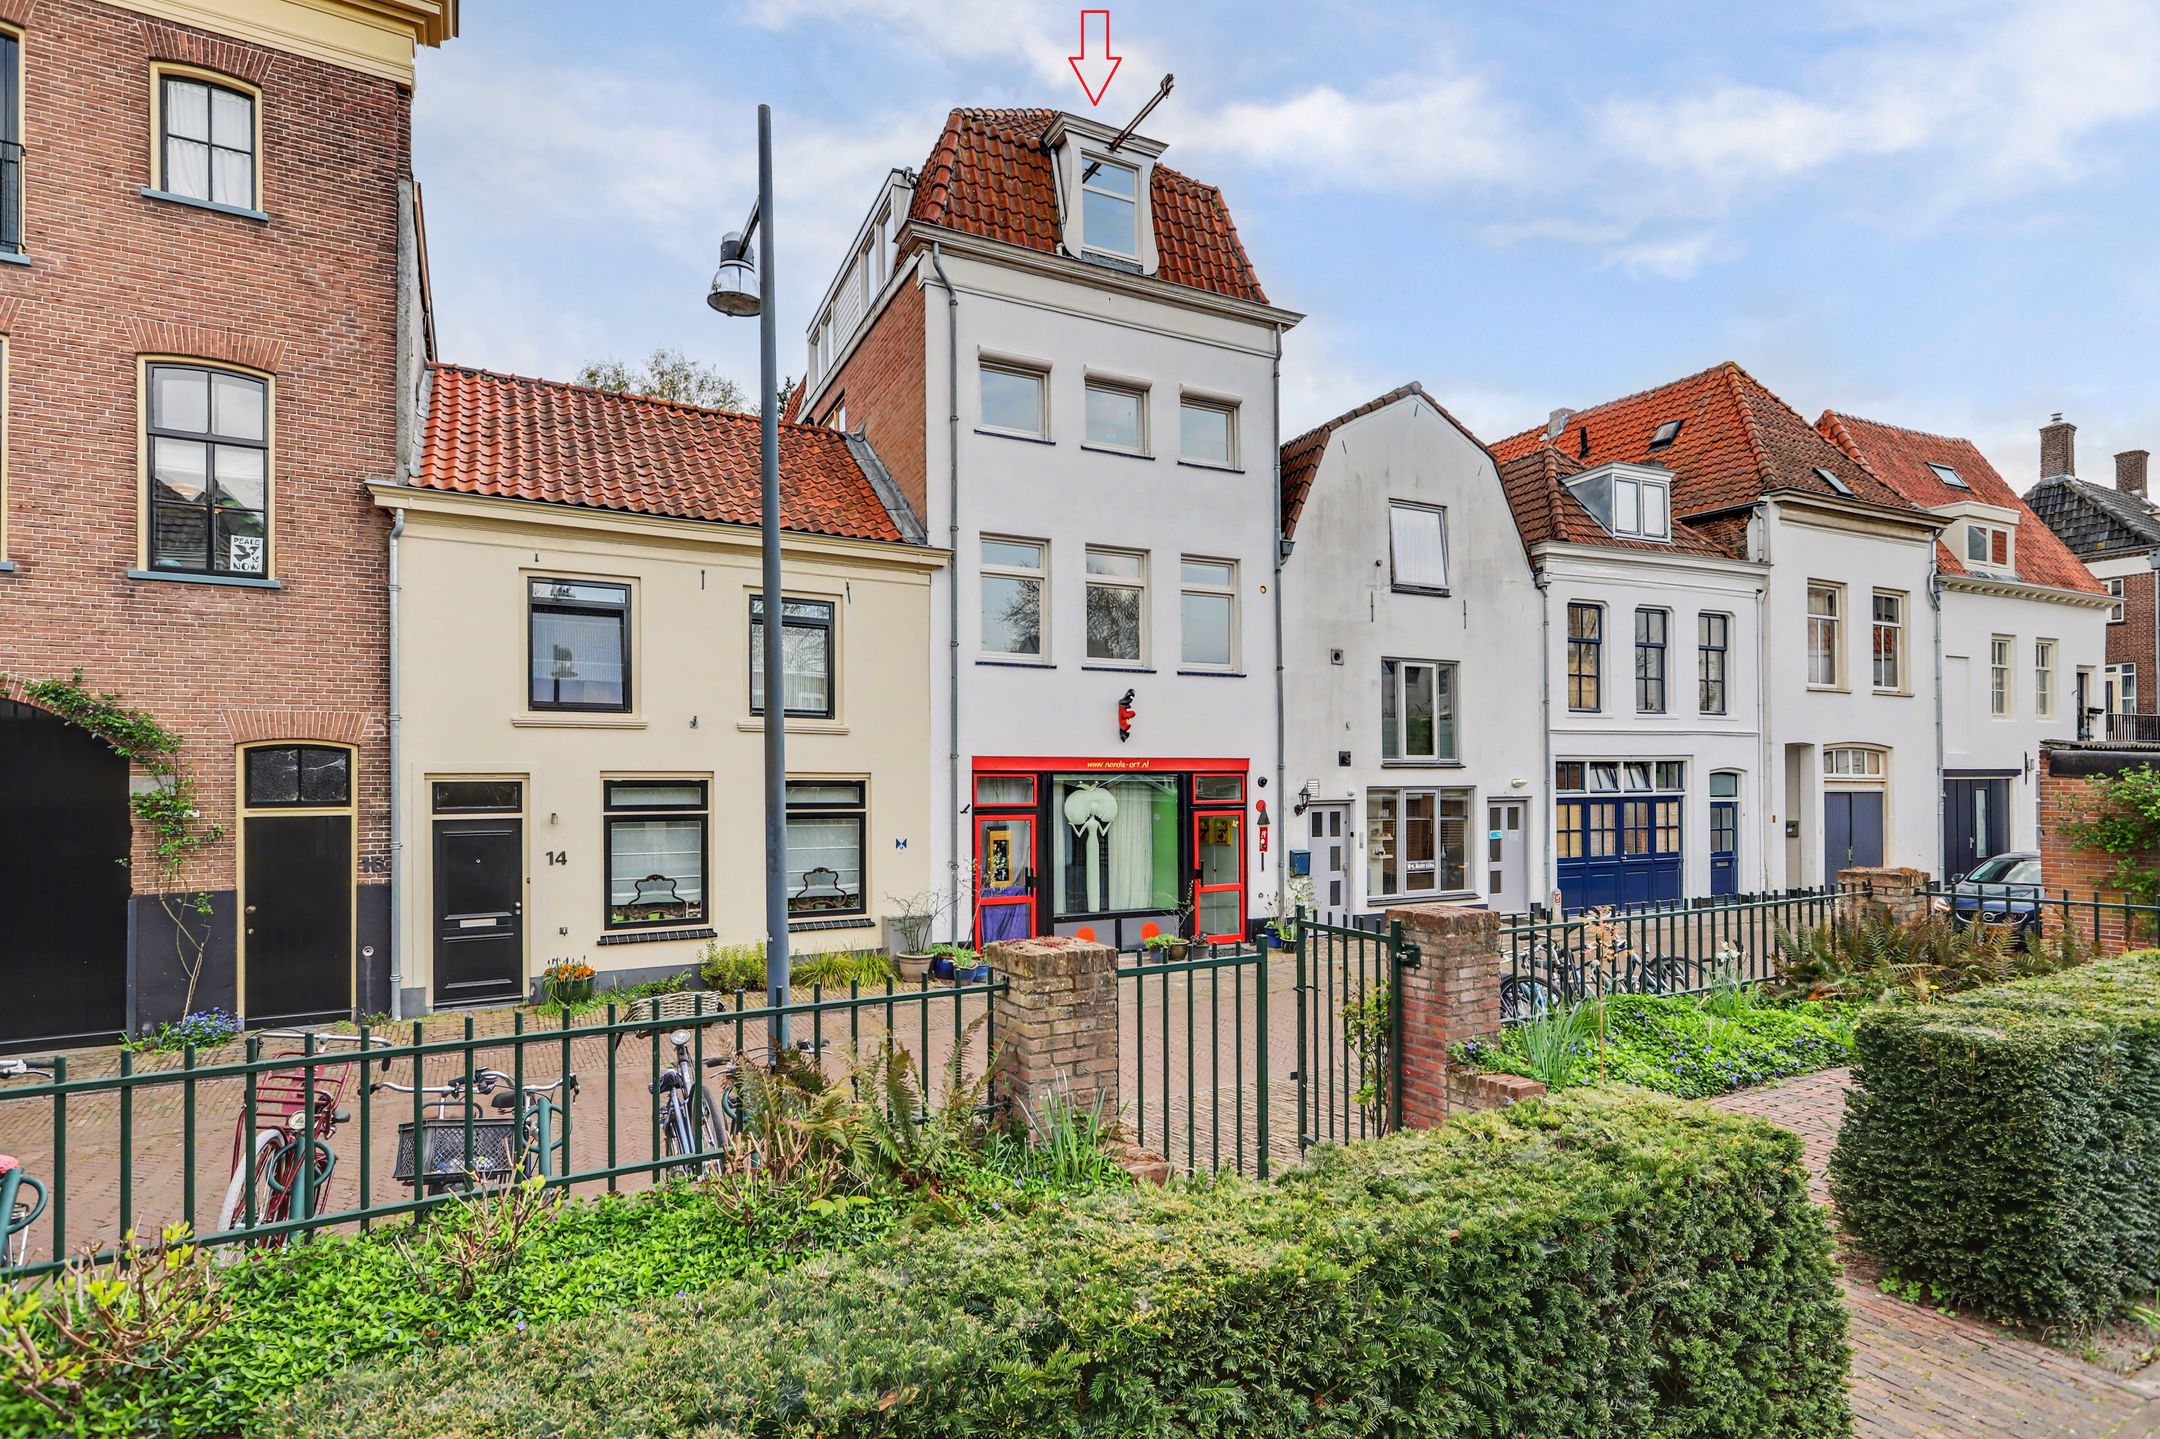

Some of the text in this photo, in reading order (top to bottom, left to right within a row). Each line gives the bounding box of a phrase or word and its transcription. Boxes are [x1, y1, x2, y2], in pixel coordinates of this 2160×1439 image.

[233, 537, 260, 546] PEACE
[233, 562, 260, 571] NOW
[545, 851, 568, 866] 14
